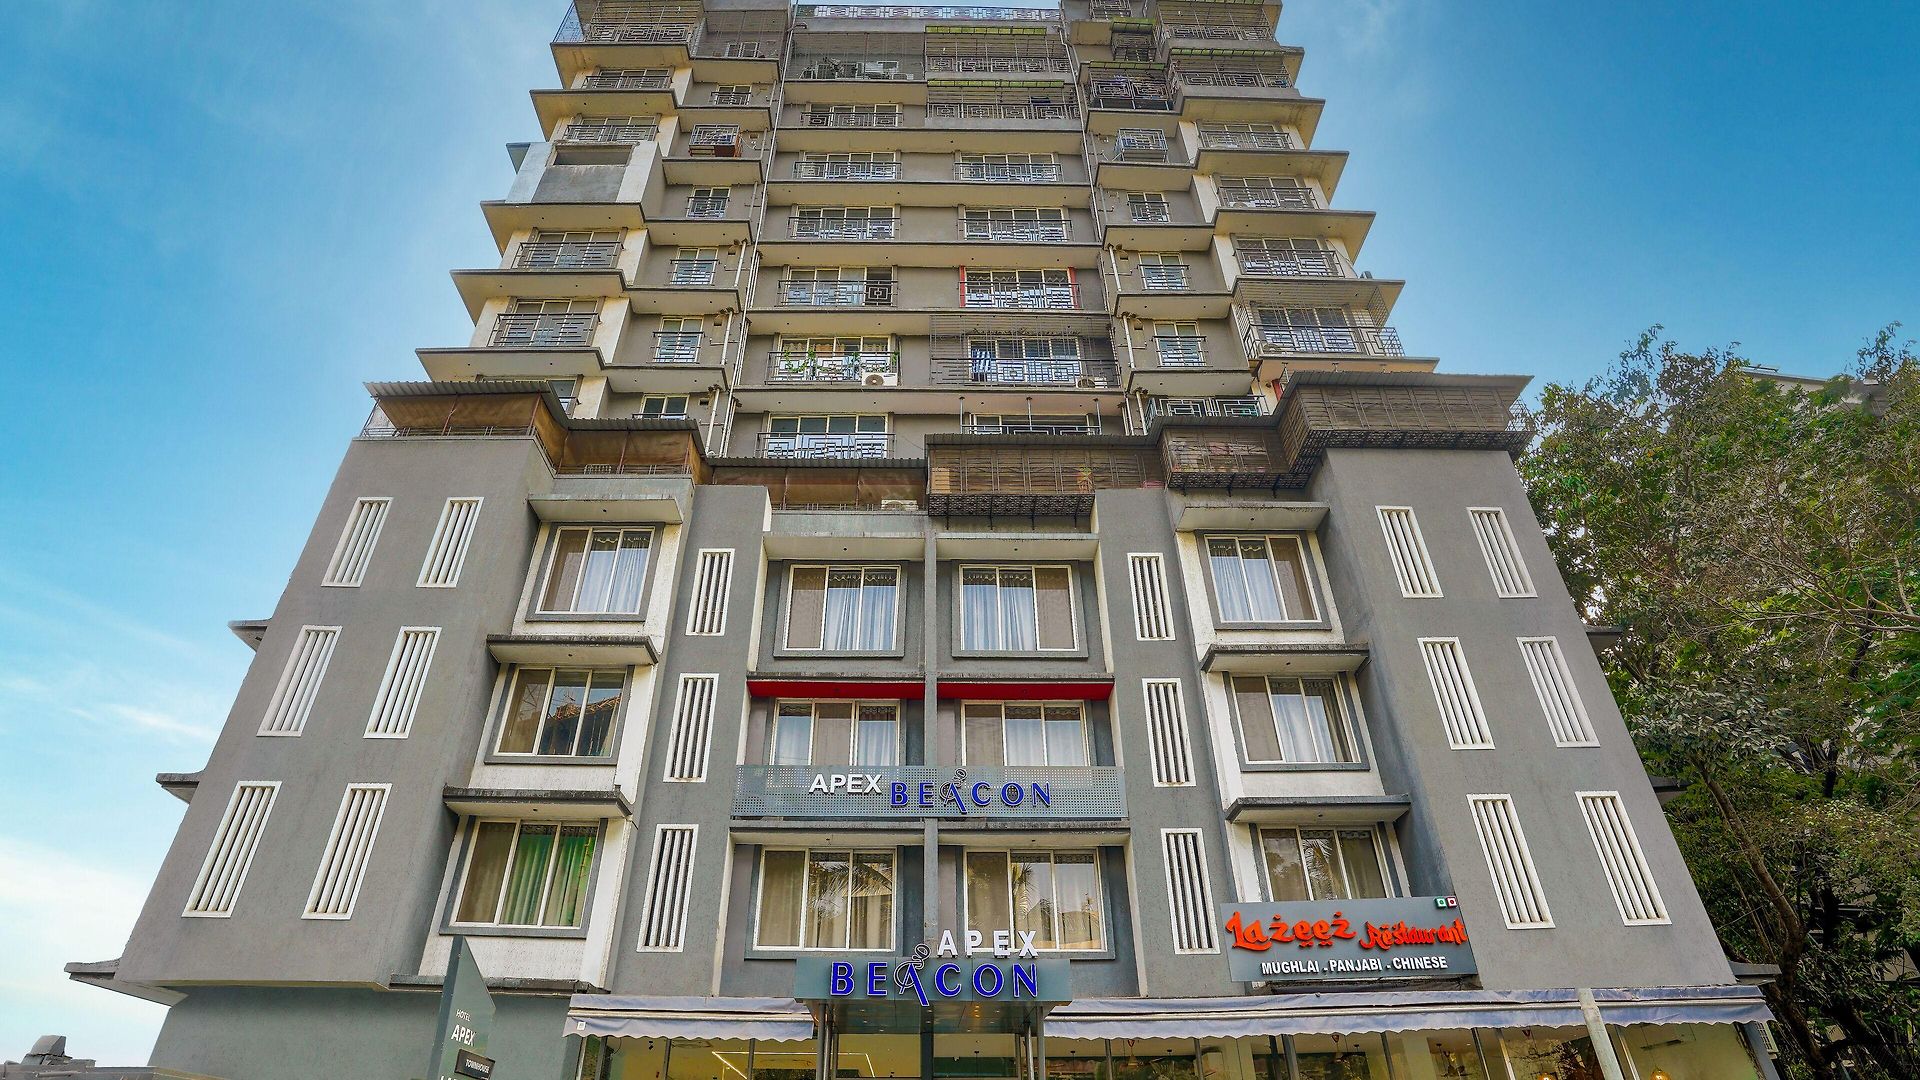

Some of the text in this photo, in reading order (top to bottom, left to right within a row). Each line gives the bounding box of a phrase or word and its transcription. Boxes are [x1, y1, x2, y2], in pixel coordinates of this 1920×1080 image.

[808, 768, 1052, 814] APEX BEACON
[937, 929, 1040, 958] APEX
[830, 943, 1039, 1007] BEACON
[1261, 956, 1448, 975] MUGHLAI PANJABI CHINESE
[456, 1009, 471, 1021] HOTEL
[451, 1024, 475, 1046] APEX
